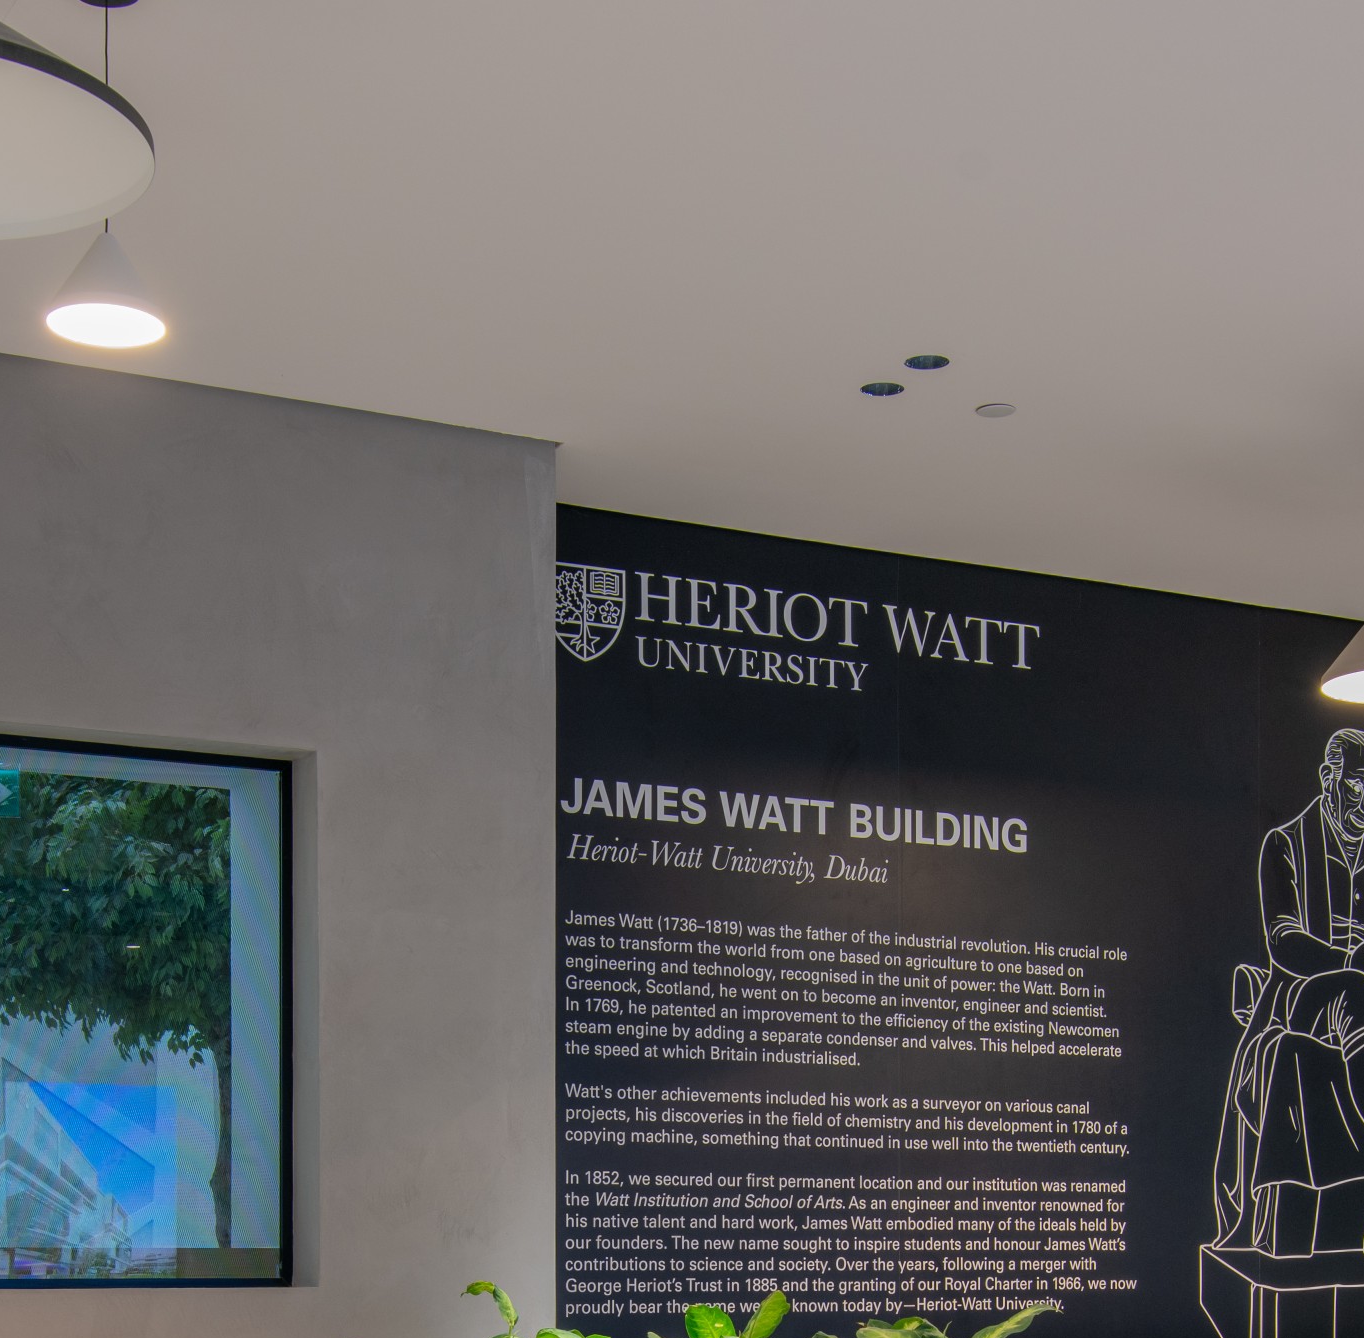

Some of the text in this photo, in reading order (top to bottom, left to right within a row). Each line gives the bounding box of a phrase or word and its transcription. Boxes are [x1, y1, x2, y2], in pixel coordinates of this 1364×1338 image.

[634, 571, 1040, 669] HERIOT WATT
[635, 636, 869, 691] UNIVERSITY
[560, 777, 1028, 853] JAMES WATT BUILDING
[566, 833, 889, 884] Heriot-Watt University, Dubai
[565, 910, 1127, 961] James Watt (1736–1819) was the father of the industrial revolution. His crucial role
[565, 935, 1084, 977] was to transform the world from one based on agriculture to one based on
[565, 954, 1105, 998] engineering and technology, recognised in the unit of power: the Watt. Born in
[565, 974, 1107, 1018] Greenock, Scotland, he went on to become an inventor, engineer and scientist.
[565, 1020, 1122, 1057] steam engine by adding a separate condenser and valves. This helped accelerate
[565, 1040, 860, 1066] the speed at which Britain industrialised.
[566, 1105, 1128, 1135] projects, his discoveries in the field of chemistry and his development in 1780 of a
[565, 1127, 1130, 1157] copying machine, something that continued in use well into the twentieth century.
[565, 1169, 1126, 1193] In 1852, we secured our first permanent location and our institution was renamed
[566, 1213, 1127, 1235] his native talent and hard work, James Watt embodied many of the ideals held by
[565, 1256, 1097, 1274] contributions to science and society. Over the years, following a merger with
